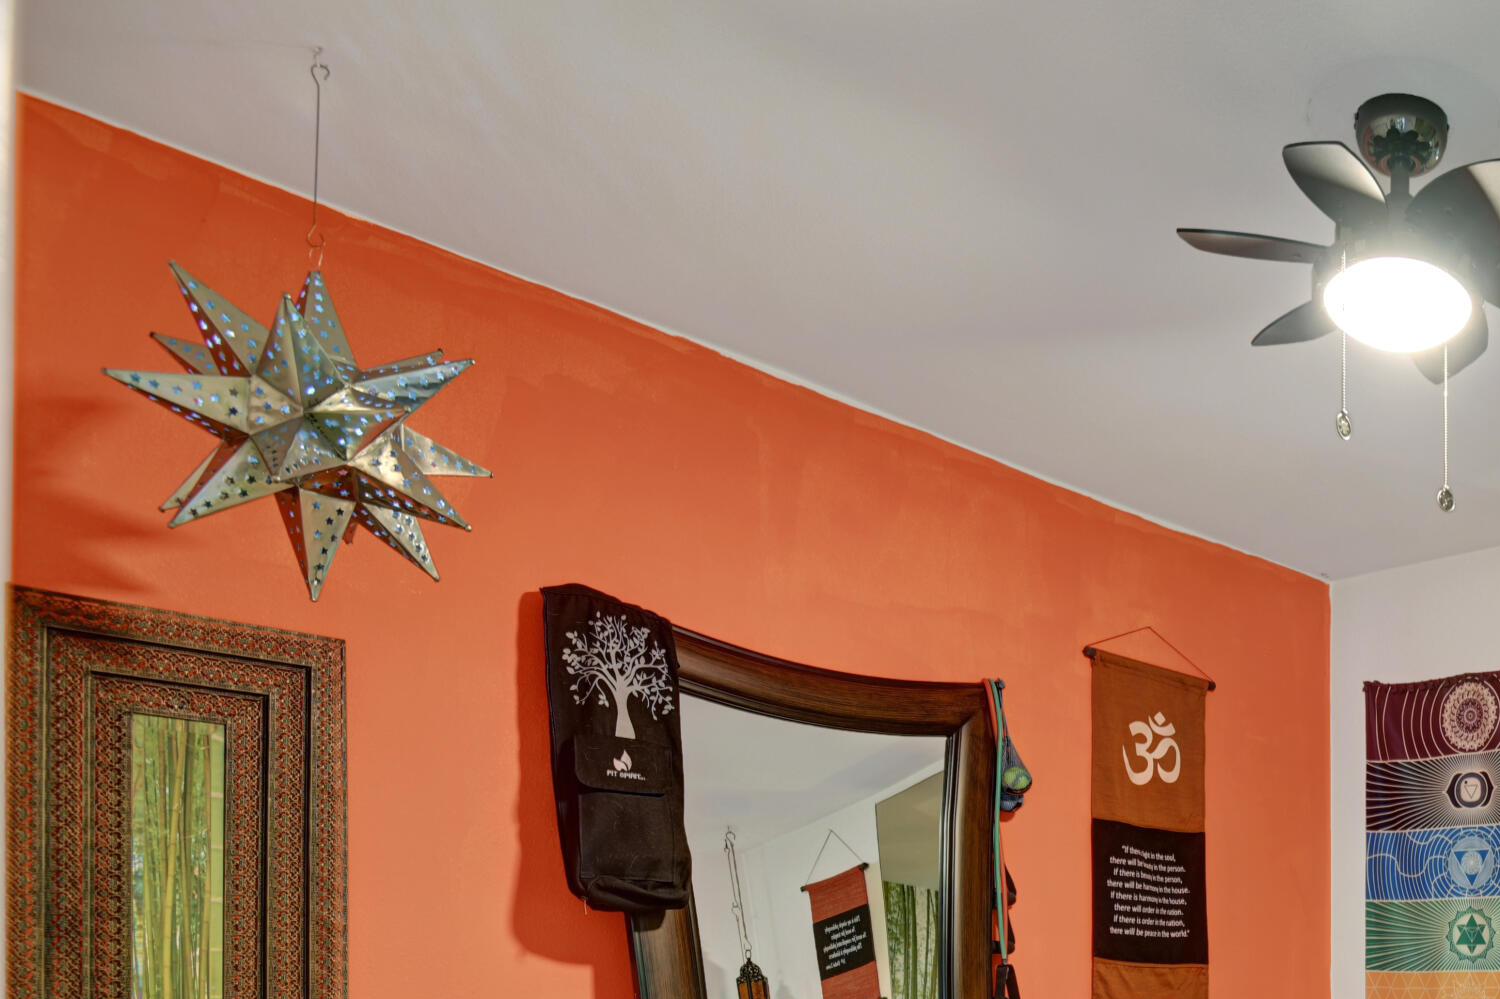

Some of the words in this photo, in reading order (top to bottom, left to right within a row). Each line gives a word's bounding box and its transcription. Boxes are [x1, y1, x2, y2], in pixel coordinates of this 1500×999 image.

[1110, 856, 1126, 865] there
[1127, 858, 1136, 866] will
[1119, 868, 1135, 877] there
[1107, 878, 1123, 888] there
[1124, 880, 1134, 889] will
[1115, 891, 1132, 901] there
[1114, 903, 1131, 912] there
[1131, 905, 1141, 913] will
[1118, 915, 1135, 924] there
[1110, 926, 1123, 935] there
[1124, 928, 1135, 936] will
